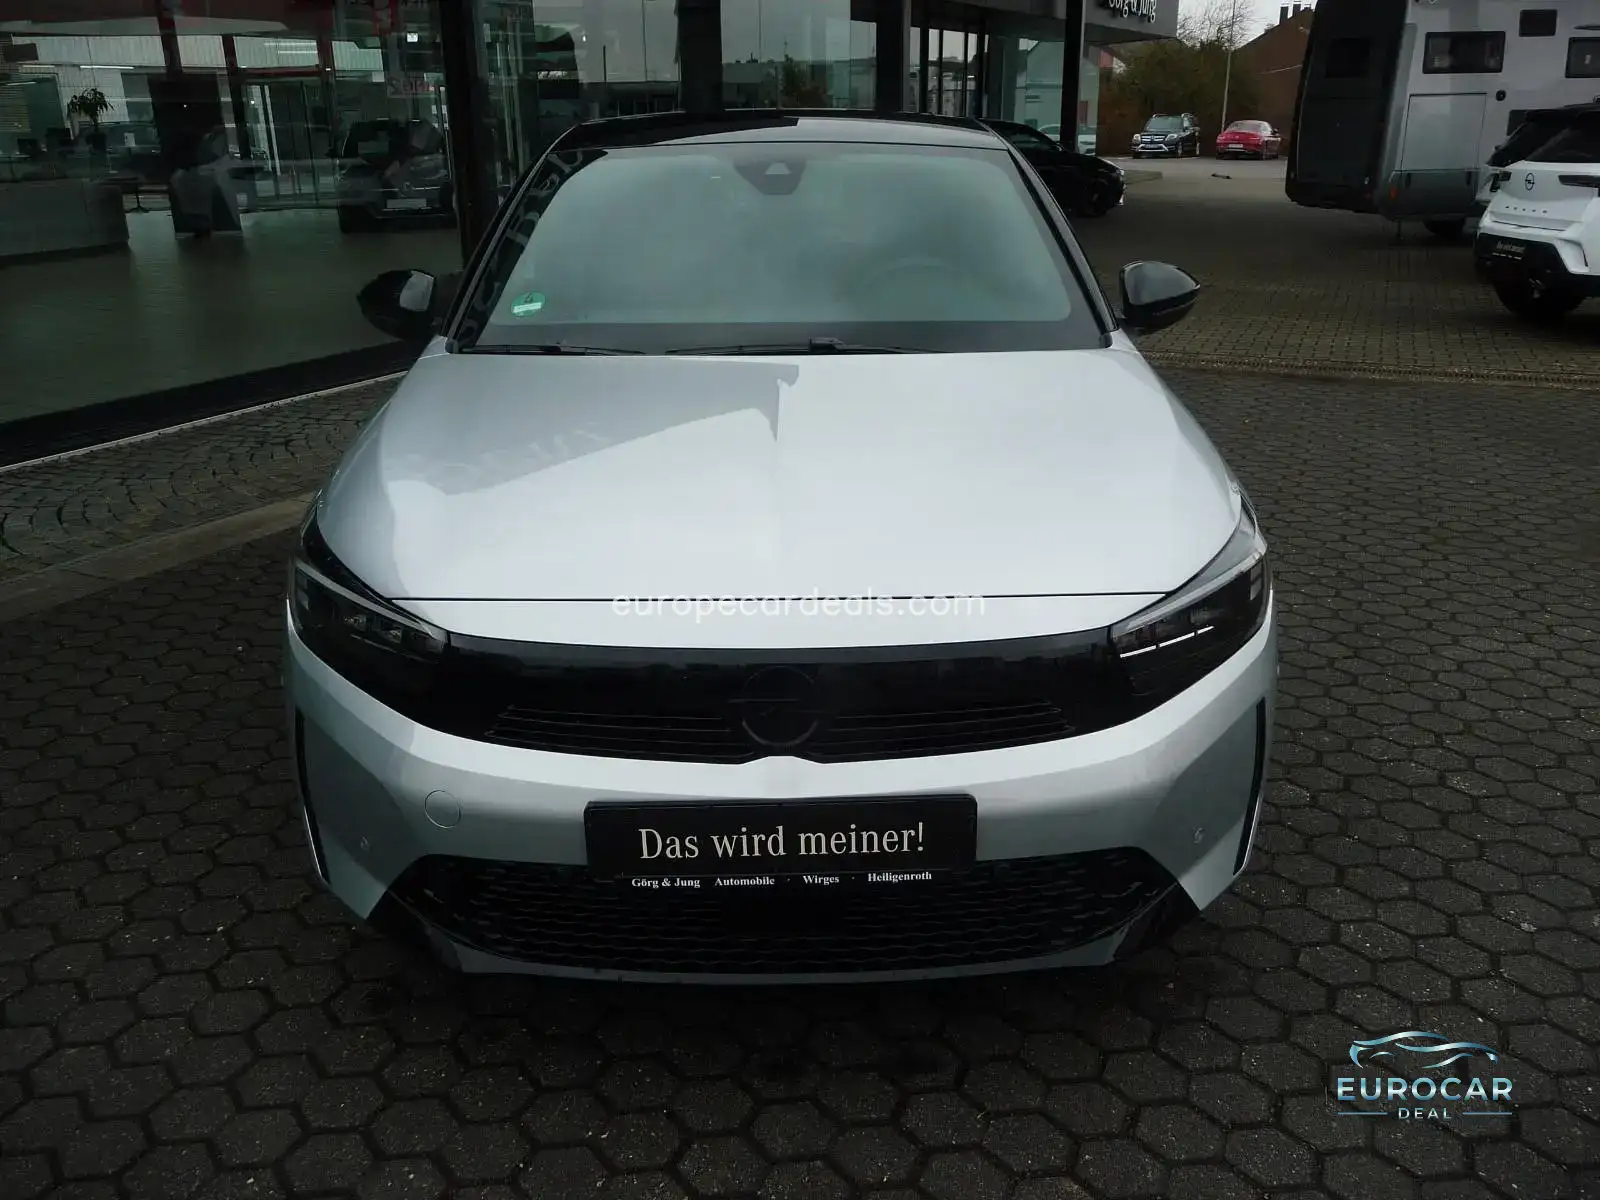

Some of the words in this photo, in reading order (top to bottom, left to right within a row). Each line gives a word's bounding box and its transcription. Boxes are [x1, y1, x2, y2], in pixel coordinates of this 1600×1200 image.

[638, 828, 699, 859] Das
[709, 825, 787, 858] wird
[797, 821, 924, 855] meiner!
[631, 878, 659, 889] Görg
[661, 878, 672, 888] &
[673, 878, 701, 889] Jung
[714, 876, 775, 887] Automobile
[802, 874, 840, 886] Wirges
[867, 871, 932, 883] Heiligenroth
